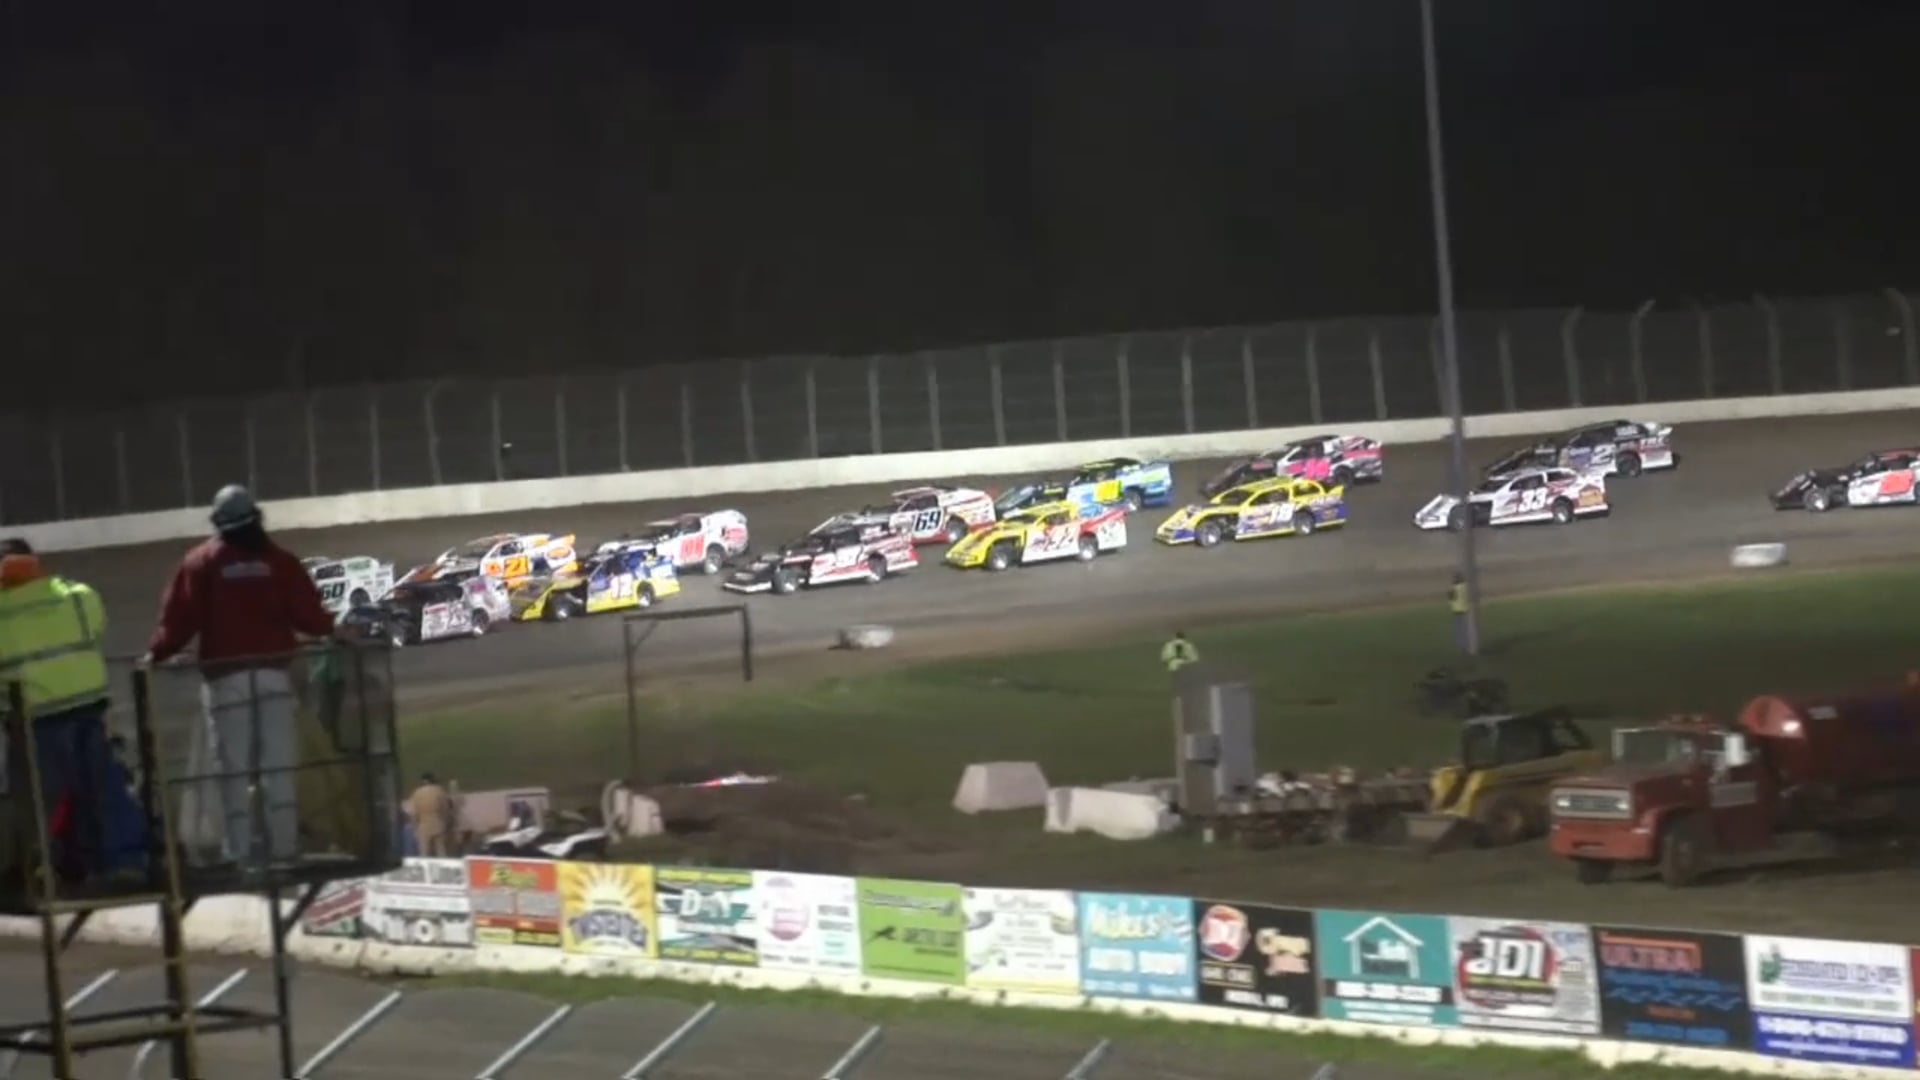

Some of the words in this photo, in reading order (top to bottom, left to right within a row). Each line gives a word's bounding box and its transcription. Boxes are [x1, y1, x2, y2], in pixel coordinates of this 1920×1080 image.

[1519, 486, 1548, 513] 33
[914, 508, 942, 532] 69
[1465, 937, 1545, 979] JDI
